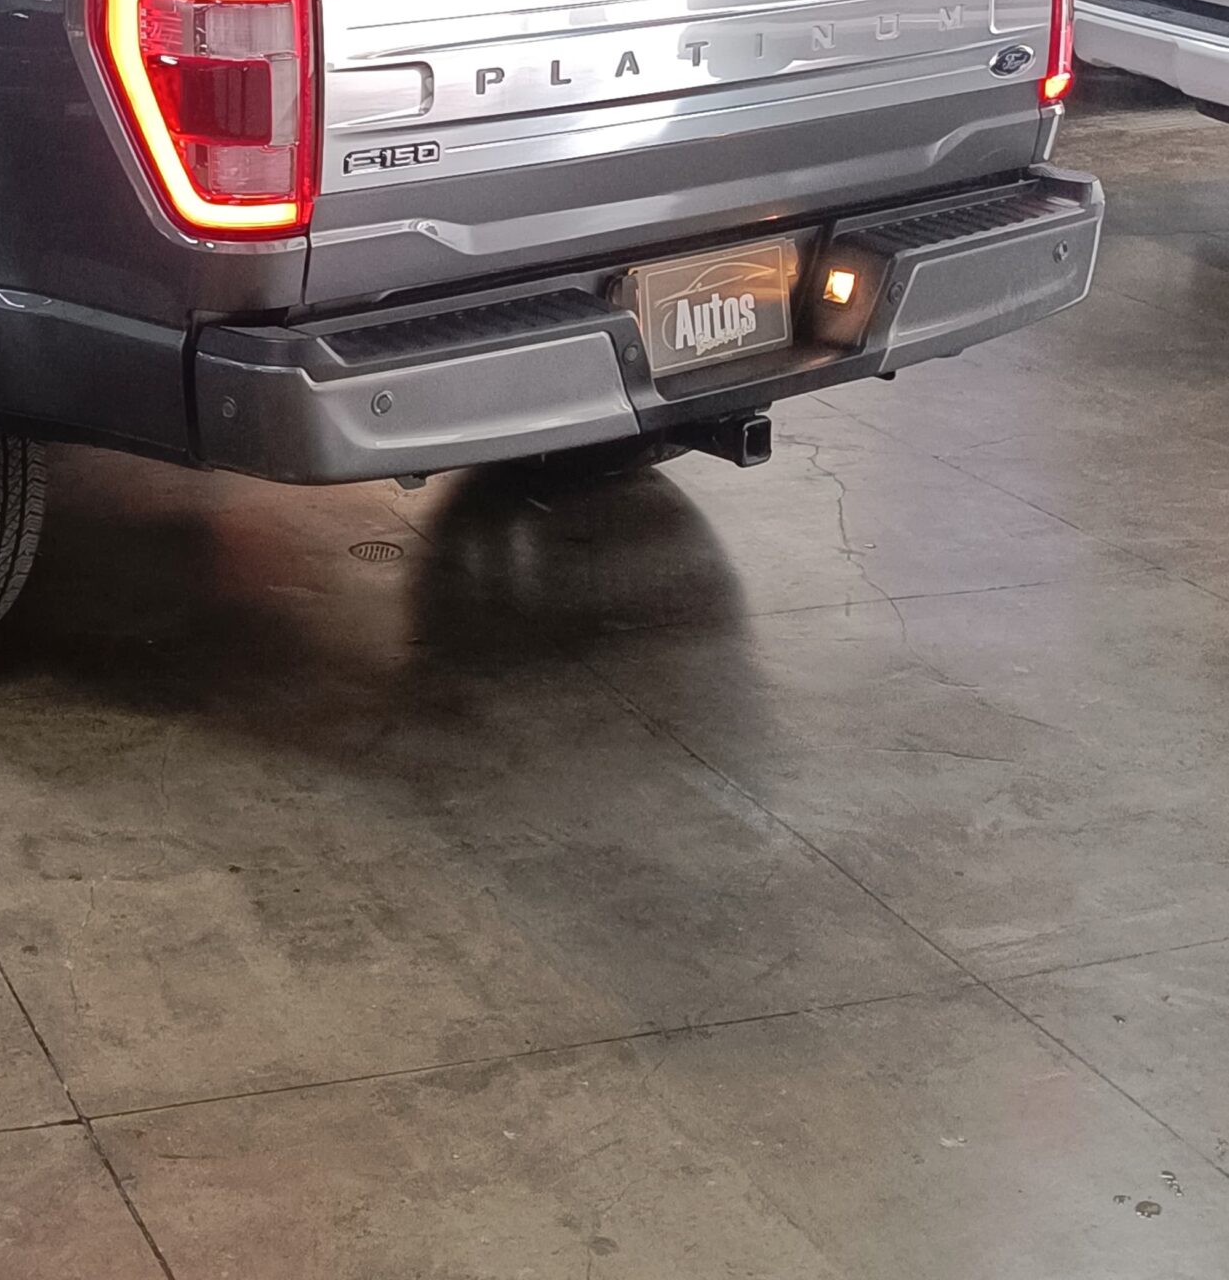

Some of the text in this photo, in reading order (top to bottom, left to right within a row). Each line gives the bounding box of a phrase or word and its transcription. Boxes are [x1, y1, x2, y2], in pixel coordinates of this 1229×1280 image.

[475, 4, 964, 95] PLATINUM
[343, 141, 440, 175] F-150
[675, 292, 756, 350] Autos
